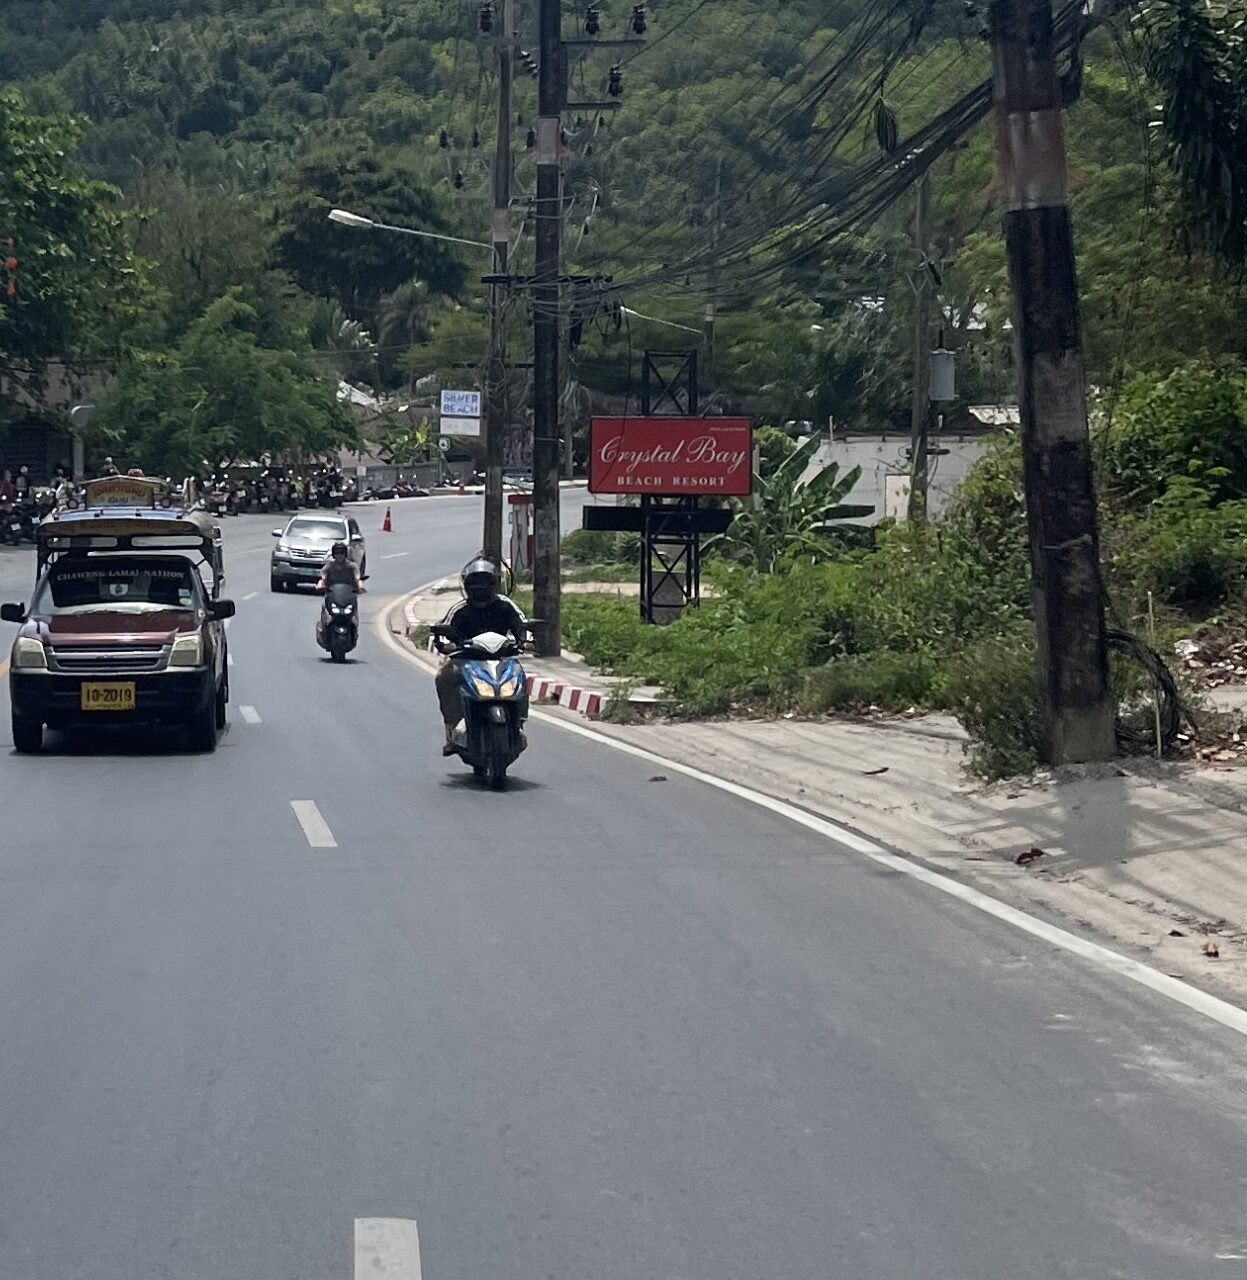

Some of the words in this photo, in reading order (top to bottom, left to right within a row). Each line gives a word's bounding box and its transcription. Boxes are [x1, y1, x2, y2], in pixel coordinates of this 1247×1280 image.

[444, 392, 478, 403] SILVER
[444, 404, 478, 414] BEACH
[598, 436, 684, 473] Crystal
[686, 435, 747, 474] Bay
[617, 476, 662, 486] BEACH
[672, 476, 725, 487] RESORT
[86, 688, 132, 703] 10-2019
